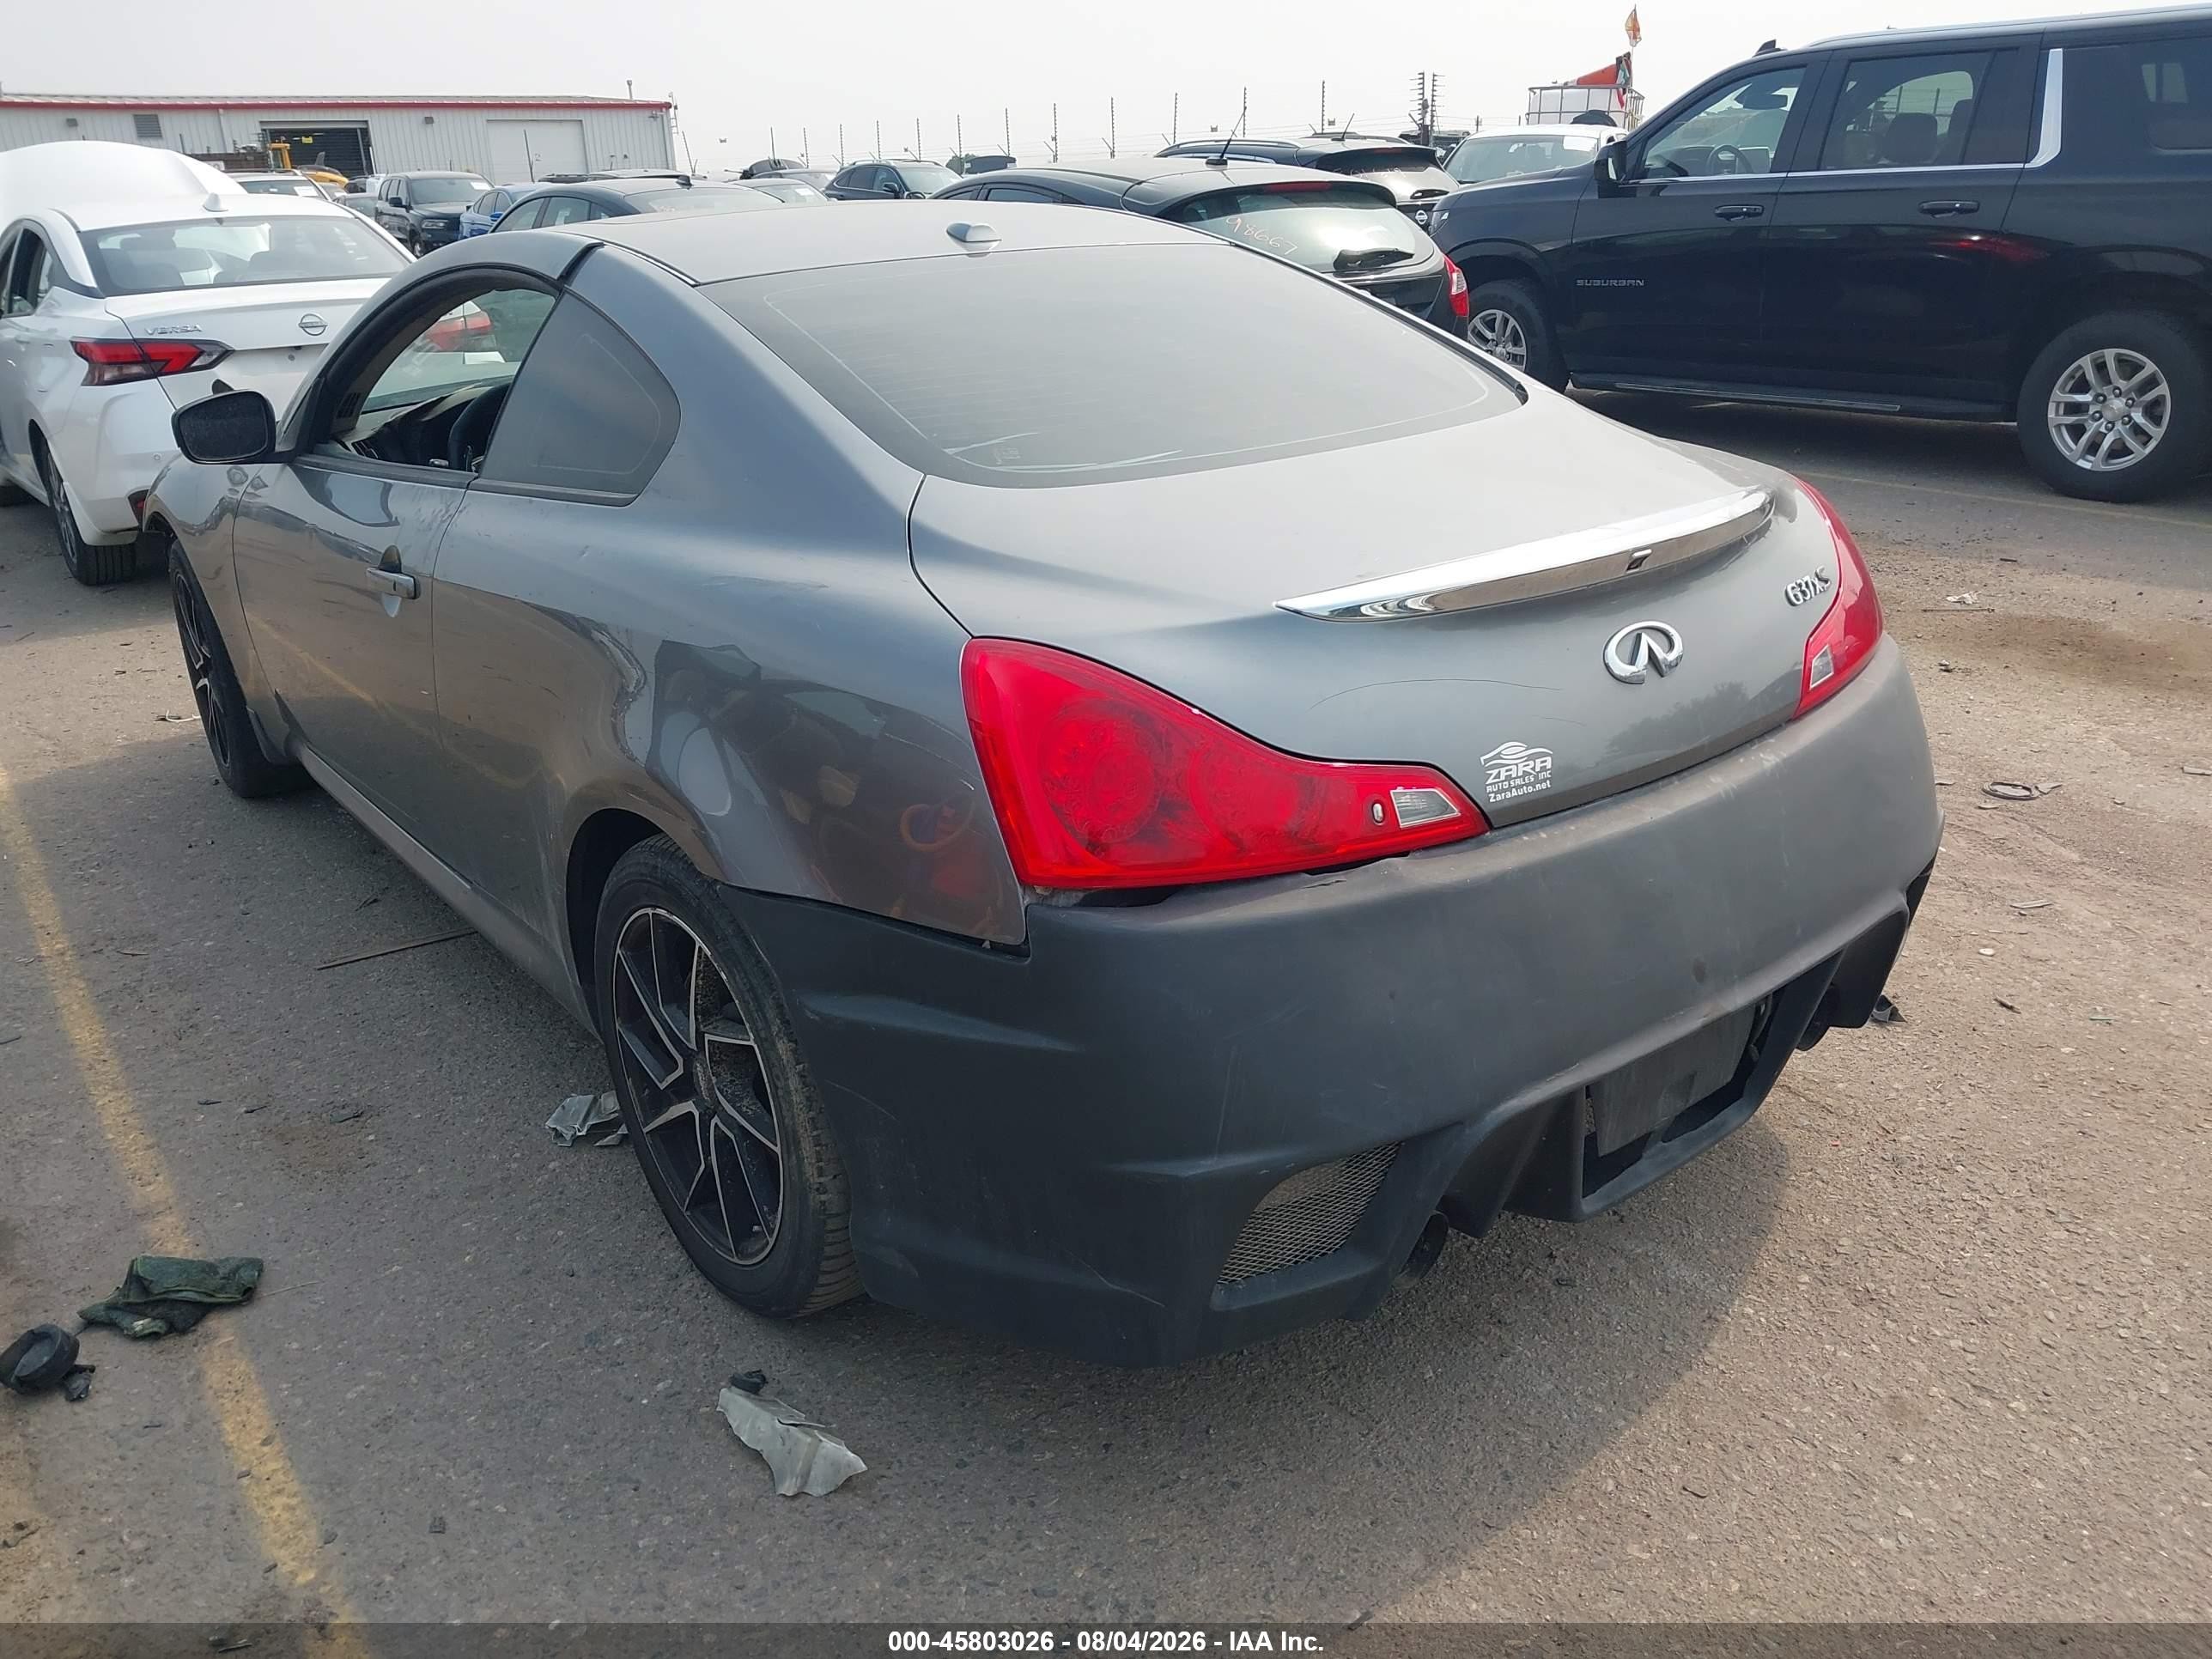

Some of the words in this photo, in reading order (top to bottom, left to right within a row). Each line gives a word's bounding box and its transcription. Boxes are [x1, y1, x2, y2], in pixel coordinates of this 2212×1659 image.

[1225, 216, 1298, 255] 98667
[144, 325, 203, 336] VERSA
[1485, 756, 1552, 785] ZARA
[1486, 781, 1510, 793] AUTO
[1510, 774, 1535, 787] SALES
[1488, 780, 1552, 803] ZaraAuto.net
